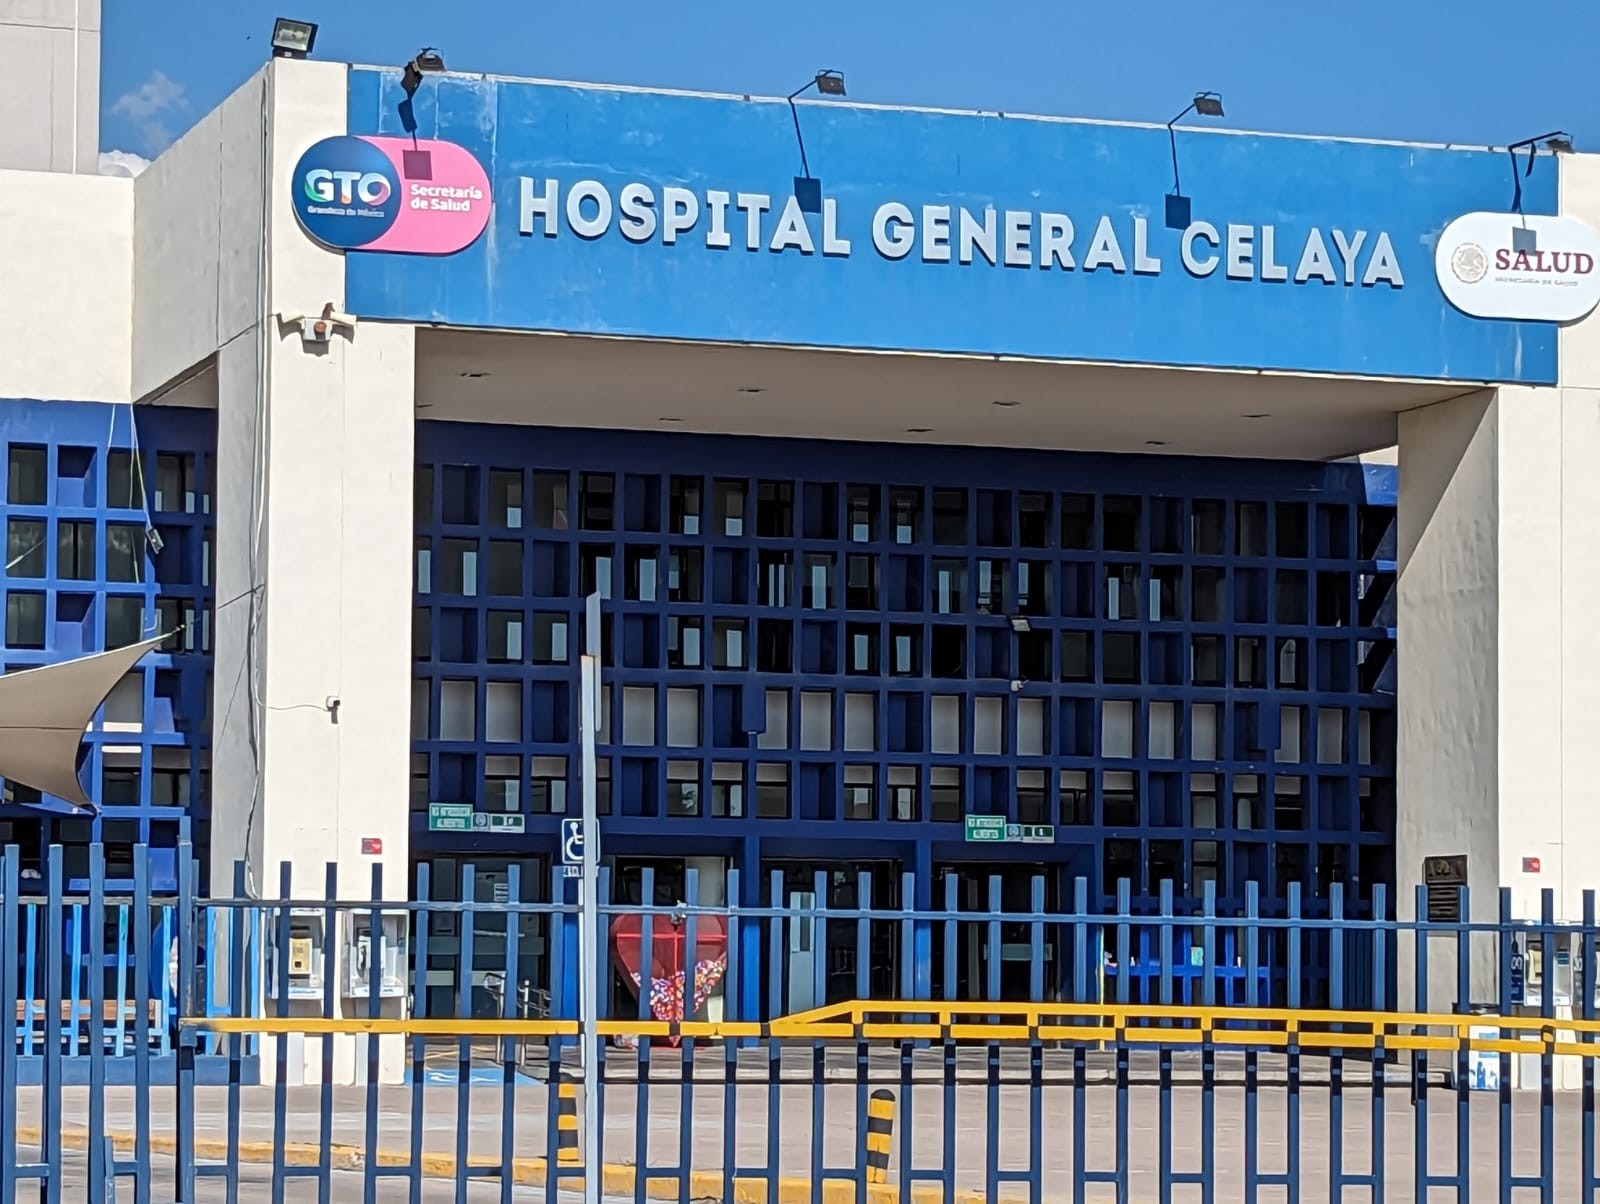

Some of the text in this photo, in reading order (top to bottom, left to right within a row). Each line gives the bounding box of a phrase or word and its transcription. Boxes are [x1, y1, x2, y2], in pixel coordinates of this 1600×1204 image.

[304, 168, 391, 206] GTO
[410, 183, 483, 199] Secretaría
[410, 197, 470, 211] de Salud
[519, 176, 1405, 288] HOSPITAL GENERAL CELAYA
[1495, 248, 1594, 274] SALUD
